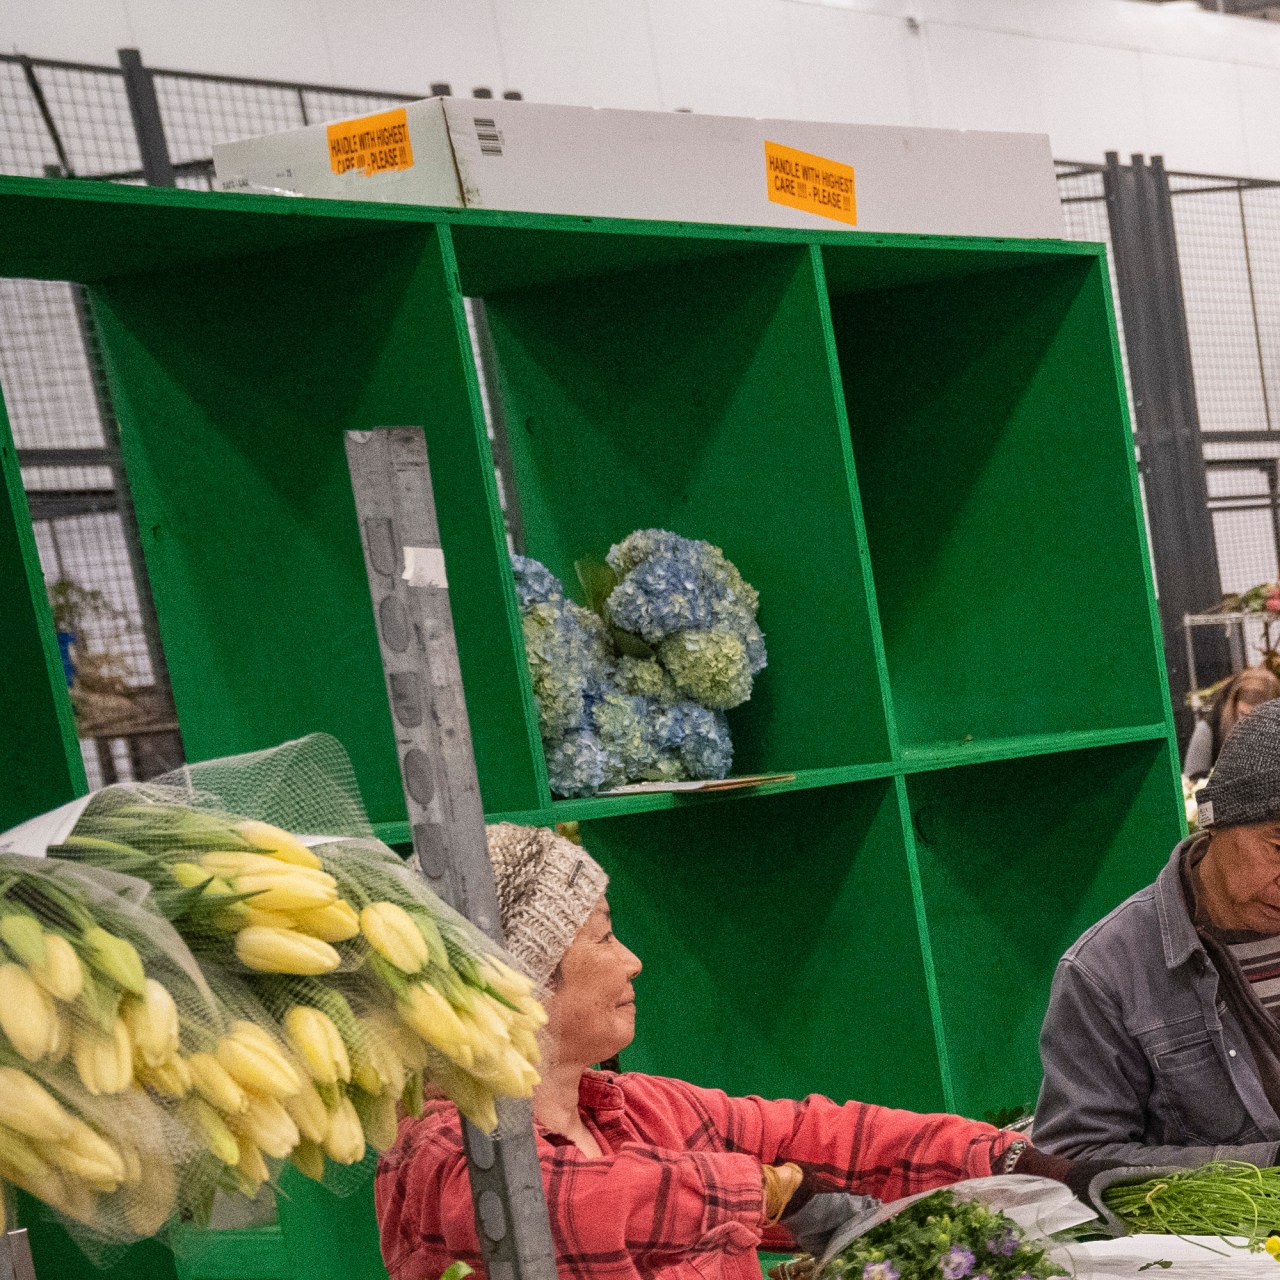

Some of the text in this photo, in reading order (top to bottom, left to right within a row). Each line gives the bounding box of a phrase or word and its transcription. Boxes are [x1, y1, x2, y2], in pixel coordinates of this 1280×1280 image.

[358, 130, 377, 150] WITH
[377, 124, 407, 146] HIGHEST
[370, 148, 398, 170] PLEASE
[768, 155, 853, 194] HANDLE WITH HIGHEST
[774, 175, 796, 196] CARE
[812, 186, 842, 210] PLEASE
